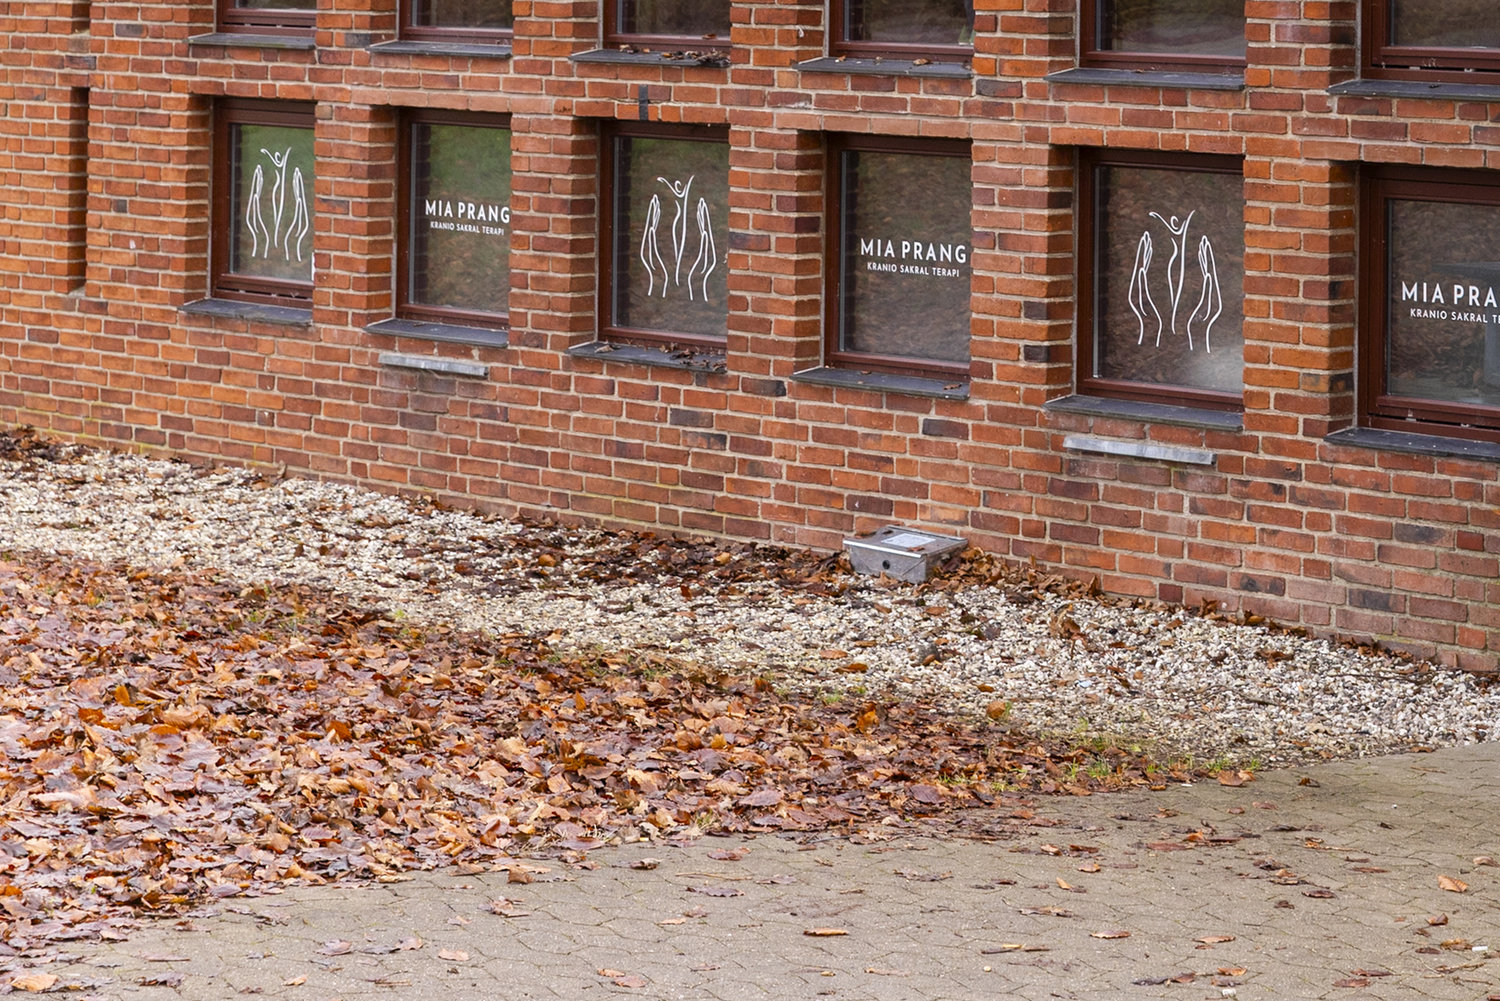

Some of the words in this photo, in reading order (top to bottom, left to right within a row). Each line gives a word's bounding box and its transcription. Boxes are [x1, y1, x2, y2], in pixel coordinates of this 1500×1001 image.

[425, 199, 453, 218] MIA
[457, 201, 510, 224] PRANG
[430, 220, 455, 231] KRANIO
[456, 223, 480, 234] SAKRAL
[482, 225, 504, 236] TERAPI
[860, 238, 895, 258] MIA
[901, 240, 967, 264] PRANG
[866, 261, 898, 273] KRANIO
[899, 264, 930, 276] SAKRAL
[932, 267, 960, 278] TERAPI
[1402, 281, 1445, 304] MIA
[1410, 308, 1448, 320] KRANIO
[1451, 311, 1488, 324] SAKRAL
